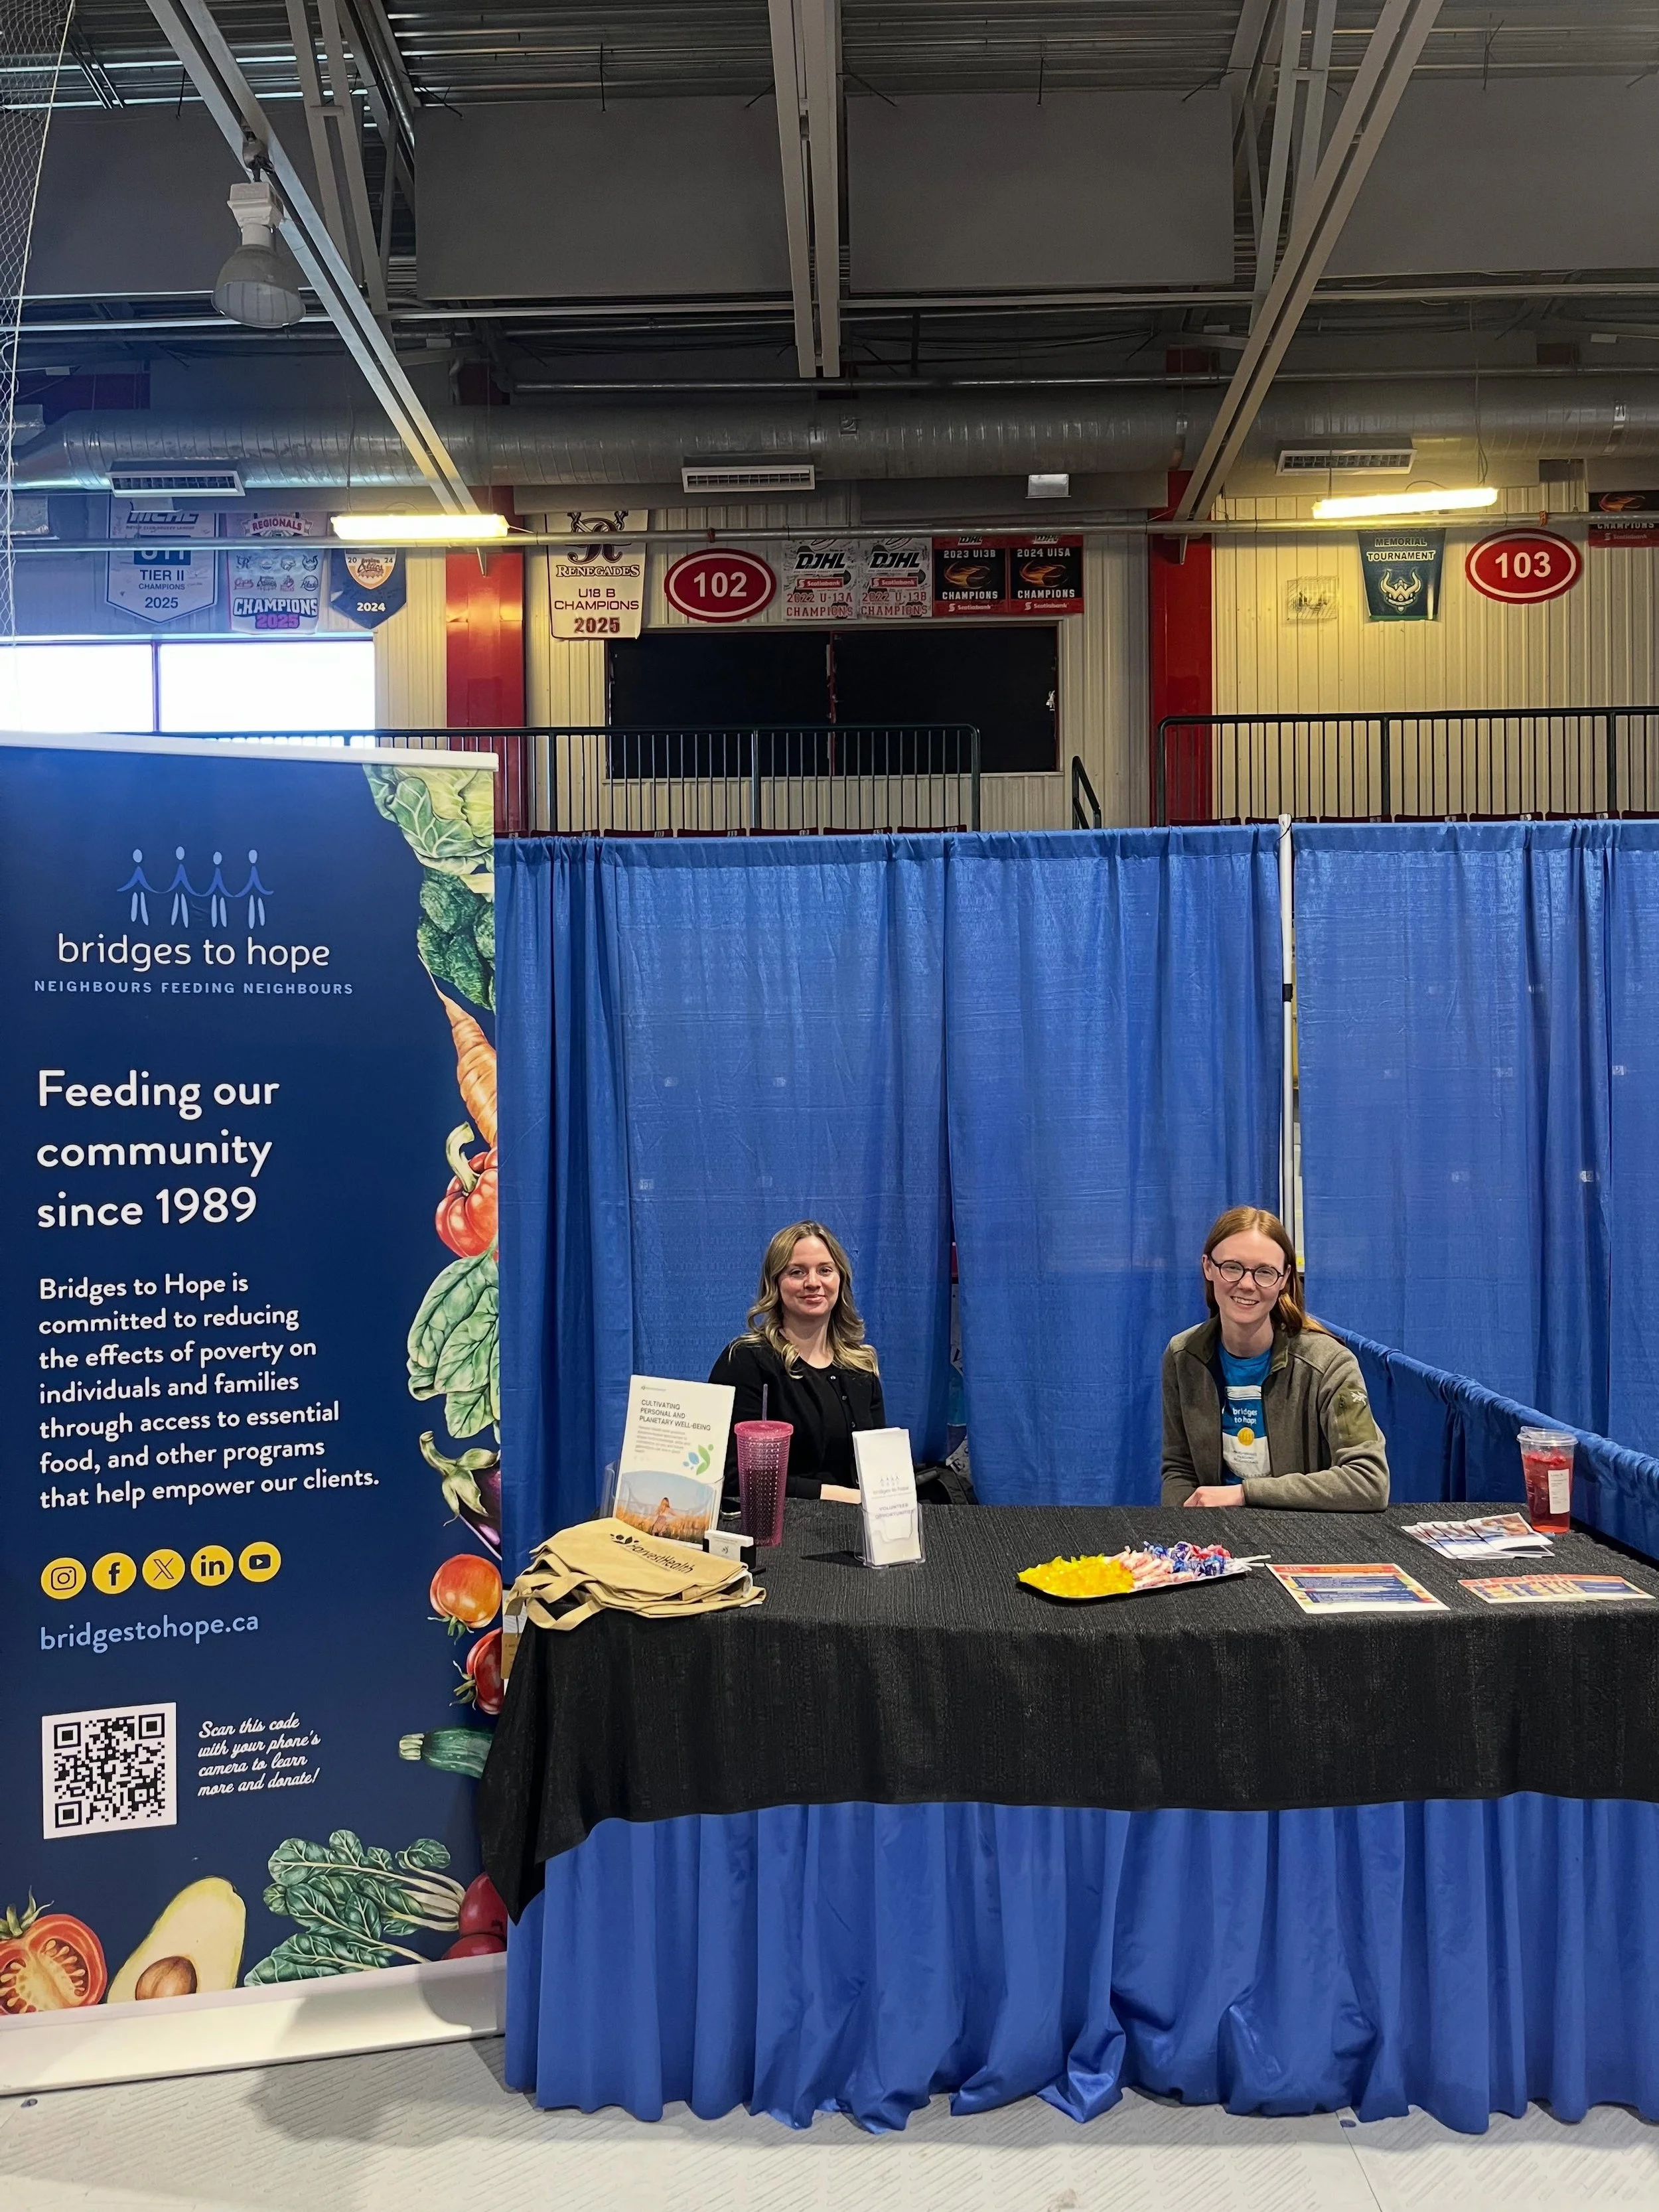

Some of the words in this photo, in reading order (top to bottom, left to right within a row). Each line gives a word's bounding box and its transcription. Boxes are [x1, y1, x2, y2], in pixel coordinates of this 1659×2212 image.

[252, 518, 302, 531] REGIONALS
[1375, 537, 1427, 547] MEMORIAL
[795, 552, 845, 569] DJHL
[869, 552, 920, 569] DJHL
[944, 550, 970, 558] 2023
[973, 550, 996, 558] U13B
[1017, 548, 1044, 557] 2024
[1047, 548, 1070, 557] U15A
[1367, 550, 1435, 561] TOURNAMENT
[556, 565, 640, 577] RENEGADES
[1495, 551, 1551, 579] 103
[140, 569, 171, 581] TIER
[177, 569, 184, 581] II
[693, 571, 747, 597] 102
[578, 588, 600, 598] U18
[607, 588, 616, 598] B
[787, 593, 815, 603] 2022
[863, 592, 890, 601] 2022
[942, 591, 998, 600] CHAMPIONS
[1017, 589, 1075, 599] CHAMPIONS
[145, 597, 179, 609] 2025
[234, 598, 318, 616] CHAMPIONS
[356, 602, 386, 612] 2024
[554, 600, 639, 611] CHAMPIONS
[861, 605, 928, 616] CHAMPIONS
[786, 607, 853, 617] CHAMPIONS
[256, 614, 299, 628] 2025
[574, 617, 620, 634] 2025
[57, 934, 192, 972] bridges
[203, 938, 236, 966] to
[248, 936, 330, 974] hope
[34, 980, 153, 994] NEIGHBOURS
[161, 982, 236, 995] FEEDING
[244, 982, 354, 995] NEIGHBOURS
[38, 1069, 202, 1121] Feeding
[213, 1081, 280, 1106] our
[36, 1128, 273, 1178] community
[37, 1191, 144, 1228] since
[155, 1186, 257, 1225] 1989
[40, 1277, 127, 1305] Bridges
[134, 1277, 157, 1295] to
[165, 1273, 226, 1301] Hope
[232, 1272, 249, 1292] is
[38, 1307, 167, 1335] committed
[174, 1309, 196, 1328] to
[203, 1304, 299, 1331] reducing
[39, 1347, 78, 1370] the
[86, 1344, 164, 1368] effects
[170, 1341, 195, 1363] of
[200, 1341, 284, 1368] poverty
[289, 1339, 317, 1357] on
[39, 1376, 161, 1404] individuals
[167, 1374, 207, 1397] and
[214, 1371, 299, 1394] families
[640, 1407, 671, 1418] PERSONAL
[641, 1399, 680, 1410] CULTIVATING
[39, 1414, 133, 1442] through
[140, 1414, 211, 1432] access
[218, 1409, 240, 1428] to
[246, 1401, 340, 1427] essential
[639, 1415, 674, 1426] PLANETARY
[675, 1421, 711, 1431] WELL-BEING
[39, 1449, 101, 1475] food,
[108, 1445, 149, 1469] and
[156, 1443, 216, 1465] other
[223, 1439, 325, 1468] programs
[40, 1487, 89, 1509] that
[96, 1481, 145, 1509] help
[152, 1479, 255, 1505] empower
[260, 1475, 297, 1493] our
[303, 1467, 380, 1490] clients.
[40, 1614, 259, 1653] bridgestohope.ca
[198, 1721, 236, 1738] Scan
[239, 1718, 265, 1733] this
[269, 1712, 300, 1730] code
[198, 1739, 229, 1757] with
[230, 1741, 265, 1759] your
[266, 1730, 321, 1754] phone's
[198, 1762, 249, 1777] camera
[252, 1758, 267, 1771] to
[271, 1751, 308, 1769] learn
[198, 1783, 234, 1797] more
[238, 1773, 266, 1792] and
[267, 1767, 321, 1789] donate!
